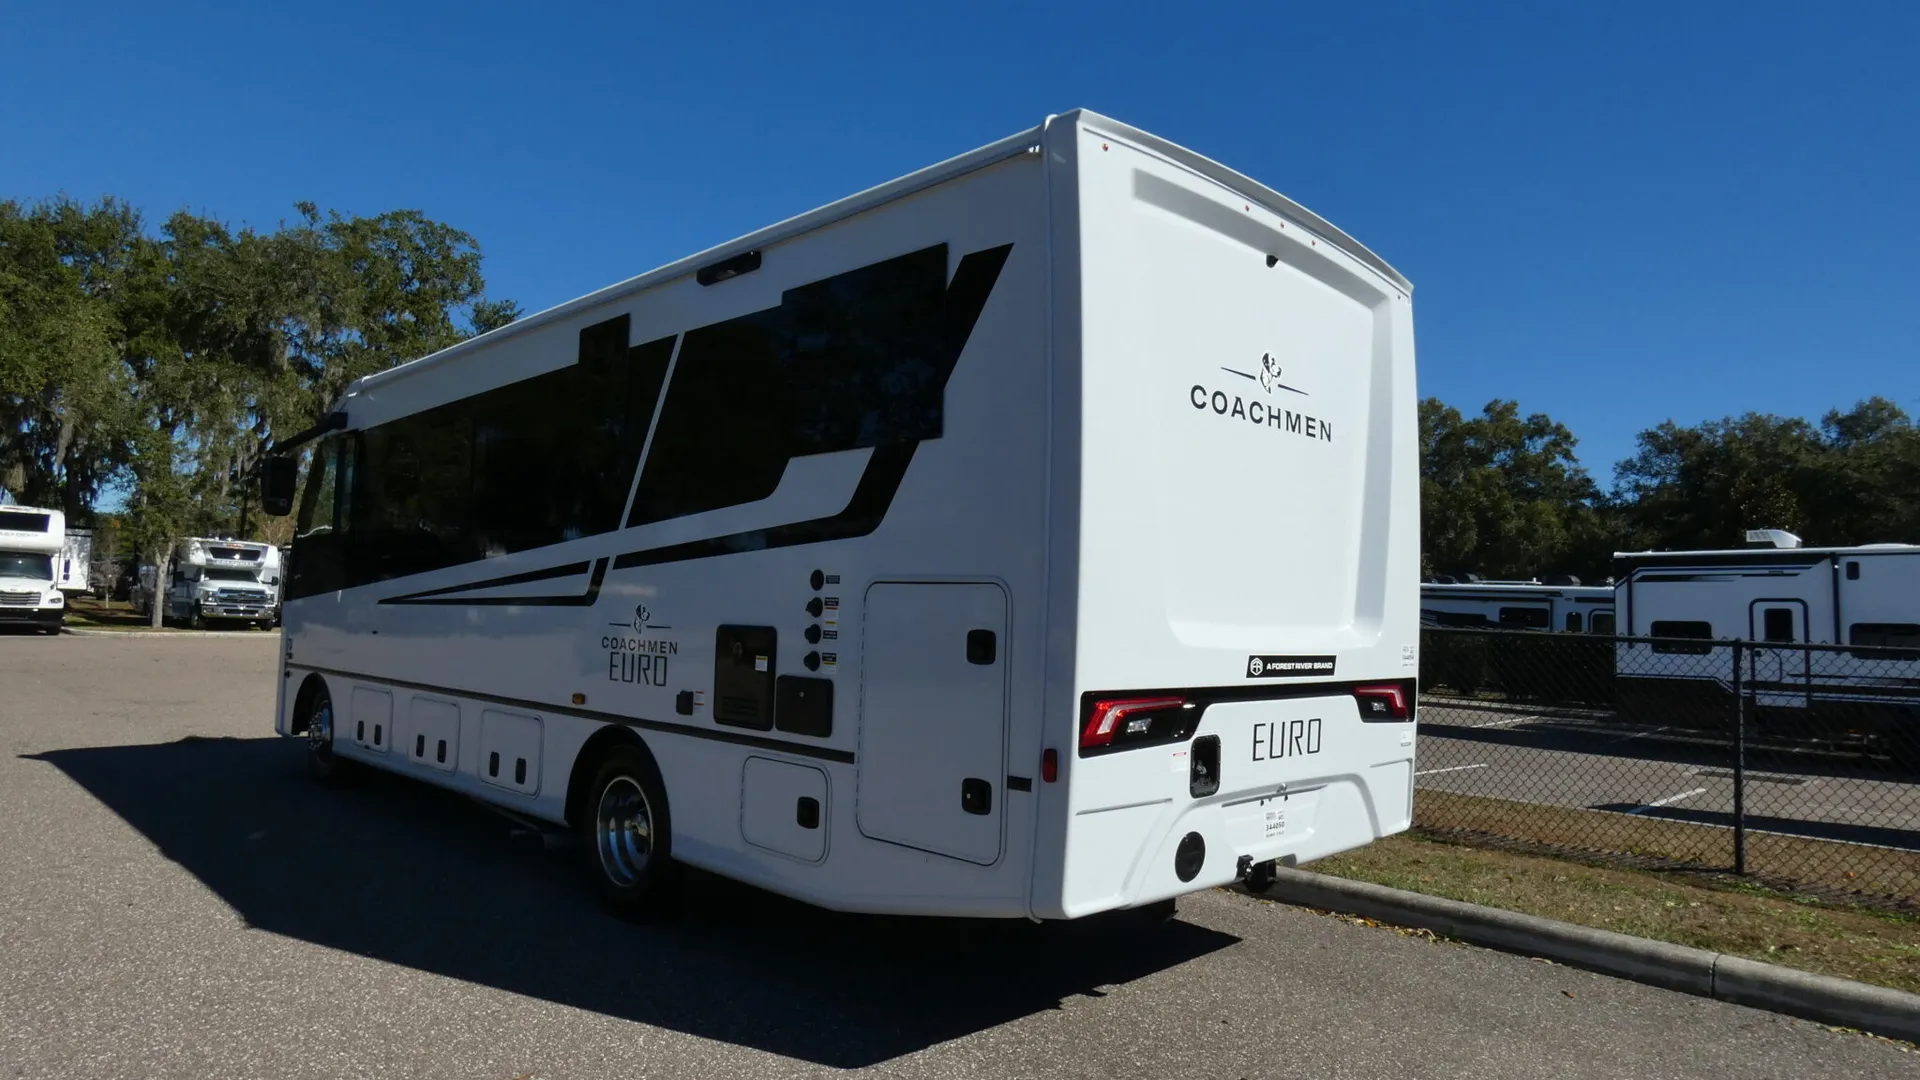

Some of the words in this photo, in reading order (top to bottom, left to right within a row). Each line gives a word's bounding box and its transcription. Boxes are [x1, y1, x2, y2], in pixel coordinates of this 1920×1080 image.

[1190, 384, 1332, 443] COACHMEN
[601, 636, 678, 655] COACHMEN
[609, 651, 668, 687] EURO
[1272, 662, 1295, 670] FOREST
[1252, 718, 1322, 762] EURO
